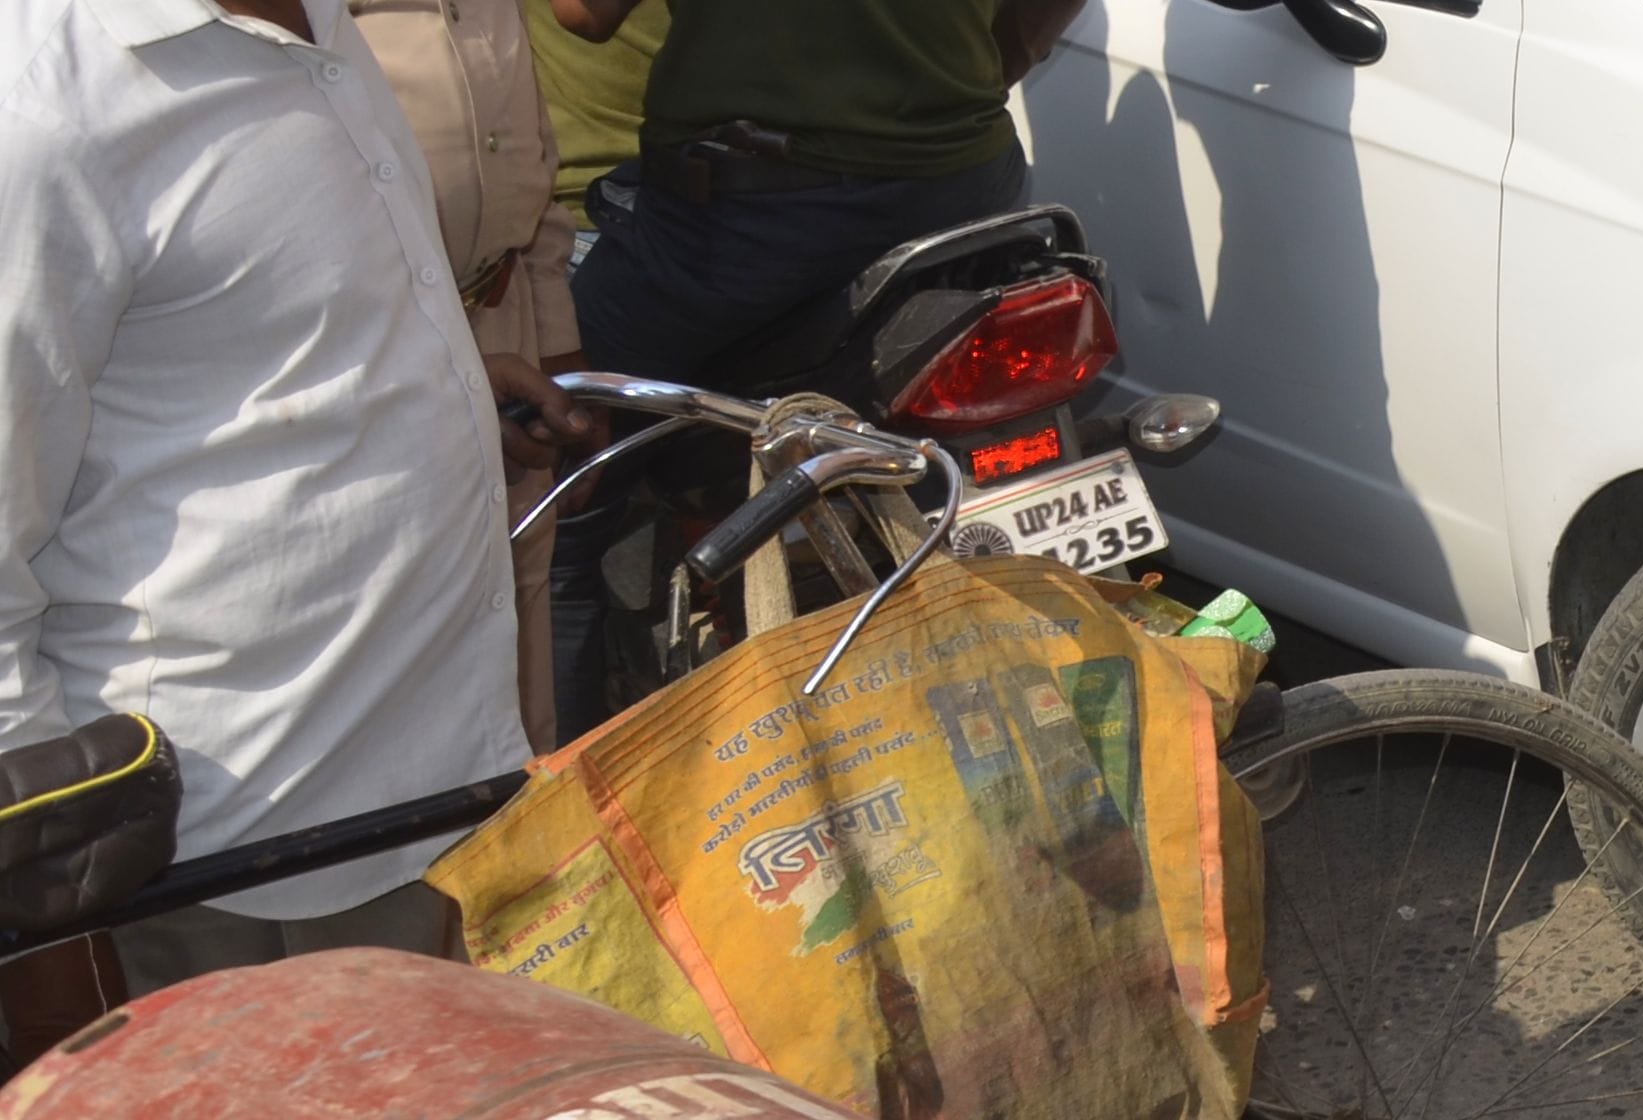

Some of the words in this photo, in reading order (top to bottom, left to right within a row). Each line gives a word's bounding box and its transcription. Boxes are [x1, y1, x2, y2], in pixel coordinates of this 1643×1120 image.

[1014, 490, 1089, 538] UP24
[1094, 478, 1129, 512] AE
[714, 731, 748, 761] यह
[852, 658, 894, 692] रही
[743, 772, 761, 791] की
[738, 779, 908, 891] तिरंगा
[507, 944, 556, 977] सरी
